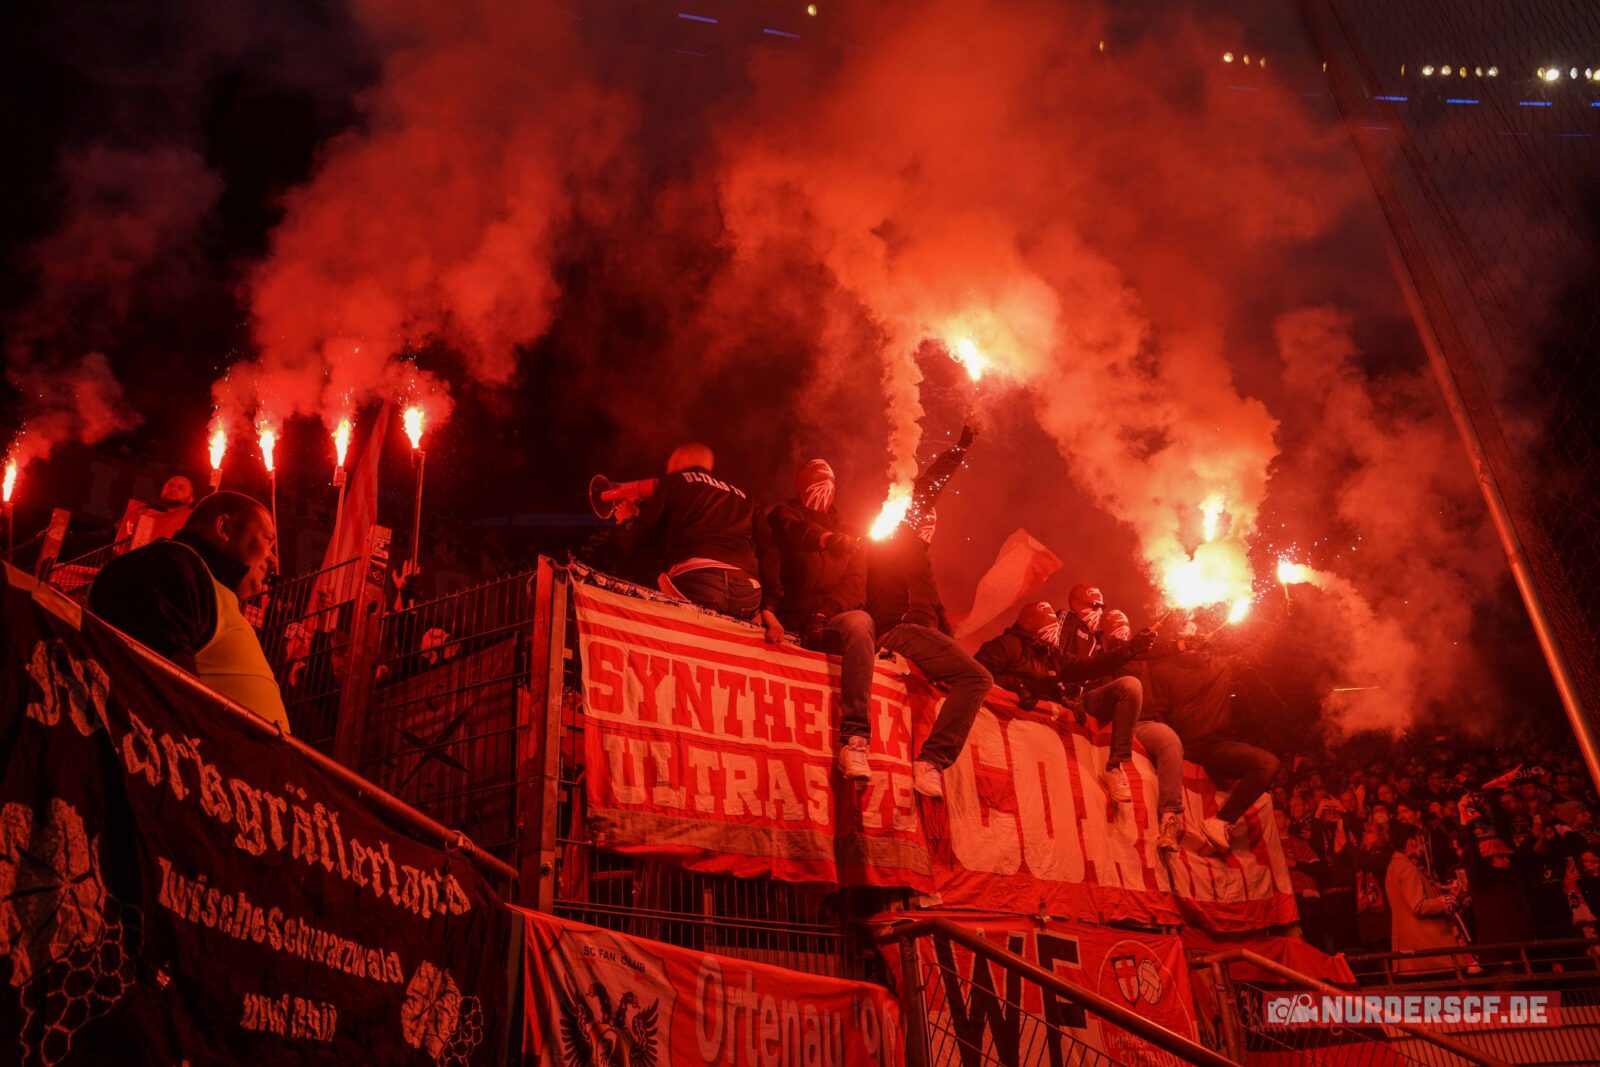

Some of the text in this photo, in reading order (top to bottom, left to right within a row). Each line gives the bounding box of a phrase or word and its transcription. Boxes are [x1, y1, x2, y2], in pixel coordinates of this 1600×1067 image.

[588, 641, 913, 764] SYNTHEIA
[603, 734, 829, 825] ULTRAS
[583, 945, 596, 957] SC
[599, 949, 616, 962] FAN
[696, 956, 846, 1067] Ortenau
